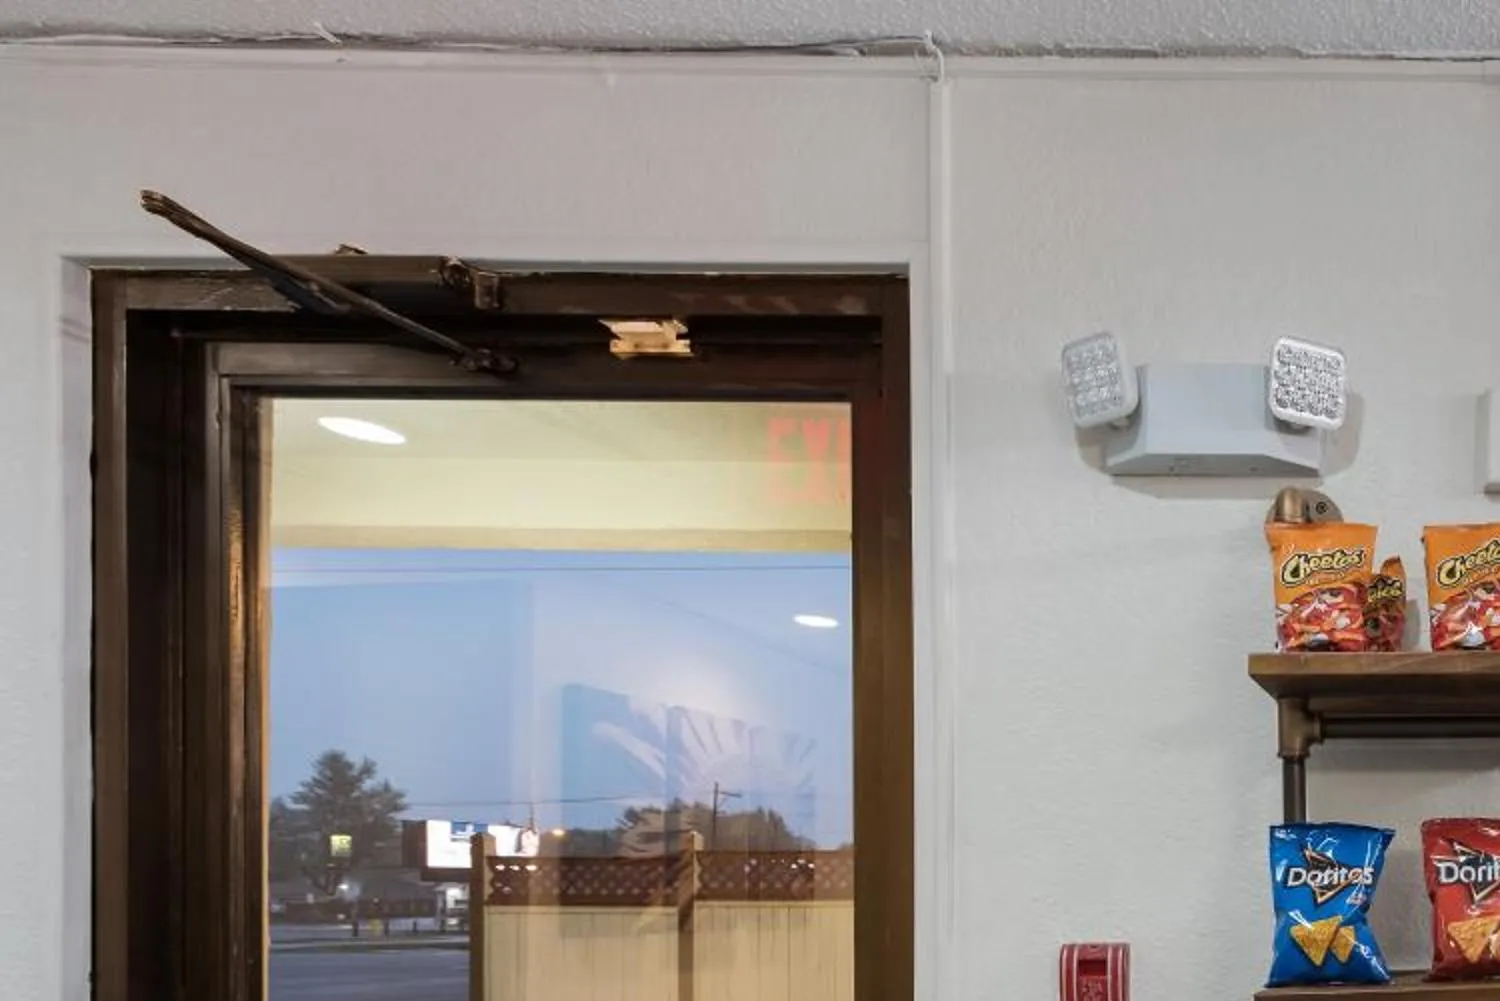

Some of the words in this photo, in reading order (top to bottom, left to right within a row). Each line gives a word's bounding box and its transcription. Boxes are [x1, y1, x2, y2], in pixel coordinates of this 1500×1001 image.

[765, 416, 850, 503] EXI
[1282, 549, 1366, 586] Cheetos
[1287, 866, 1375, 887] Doritos
